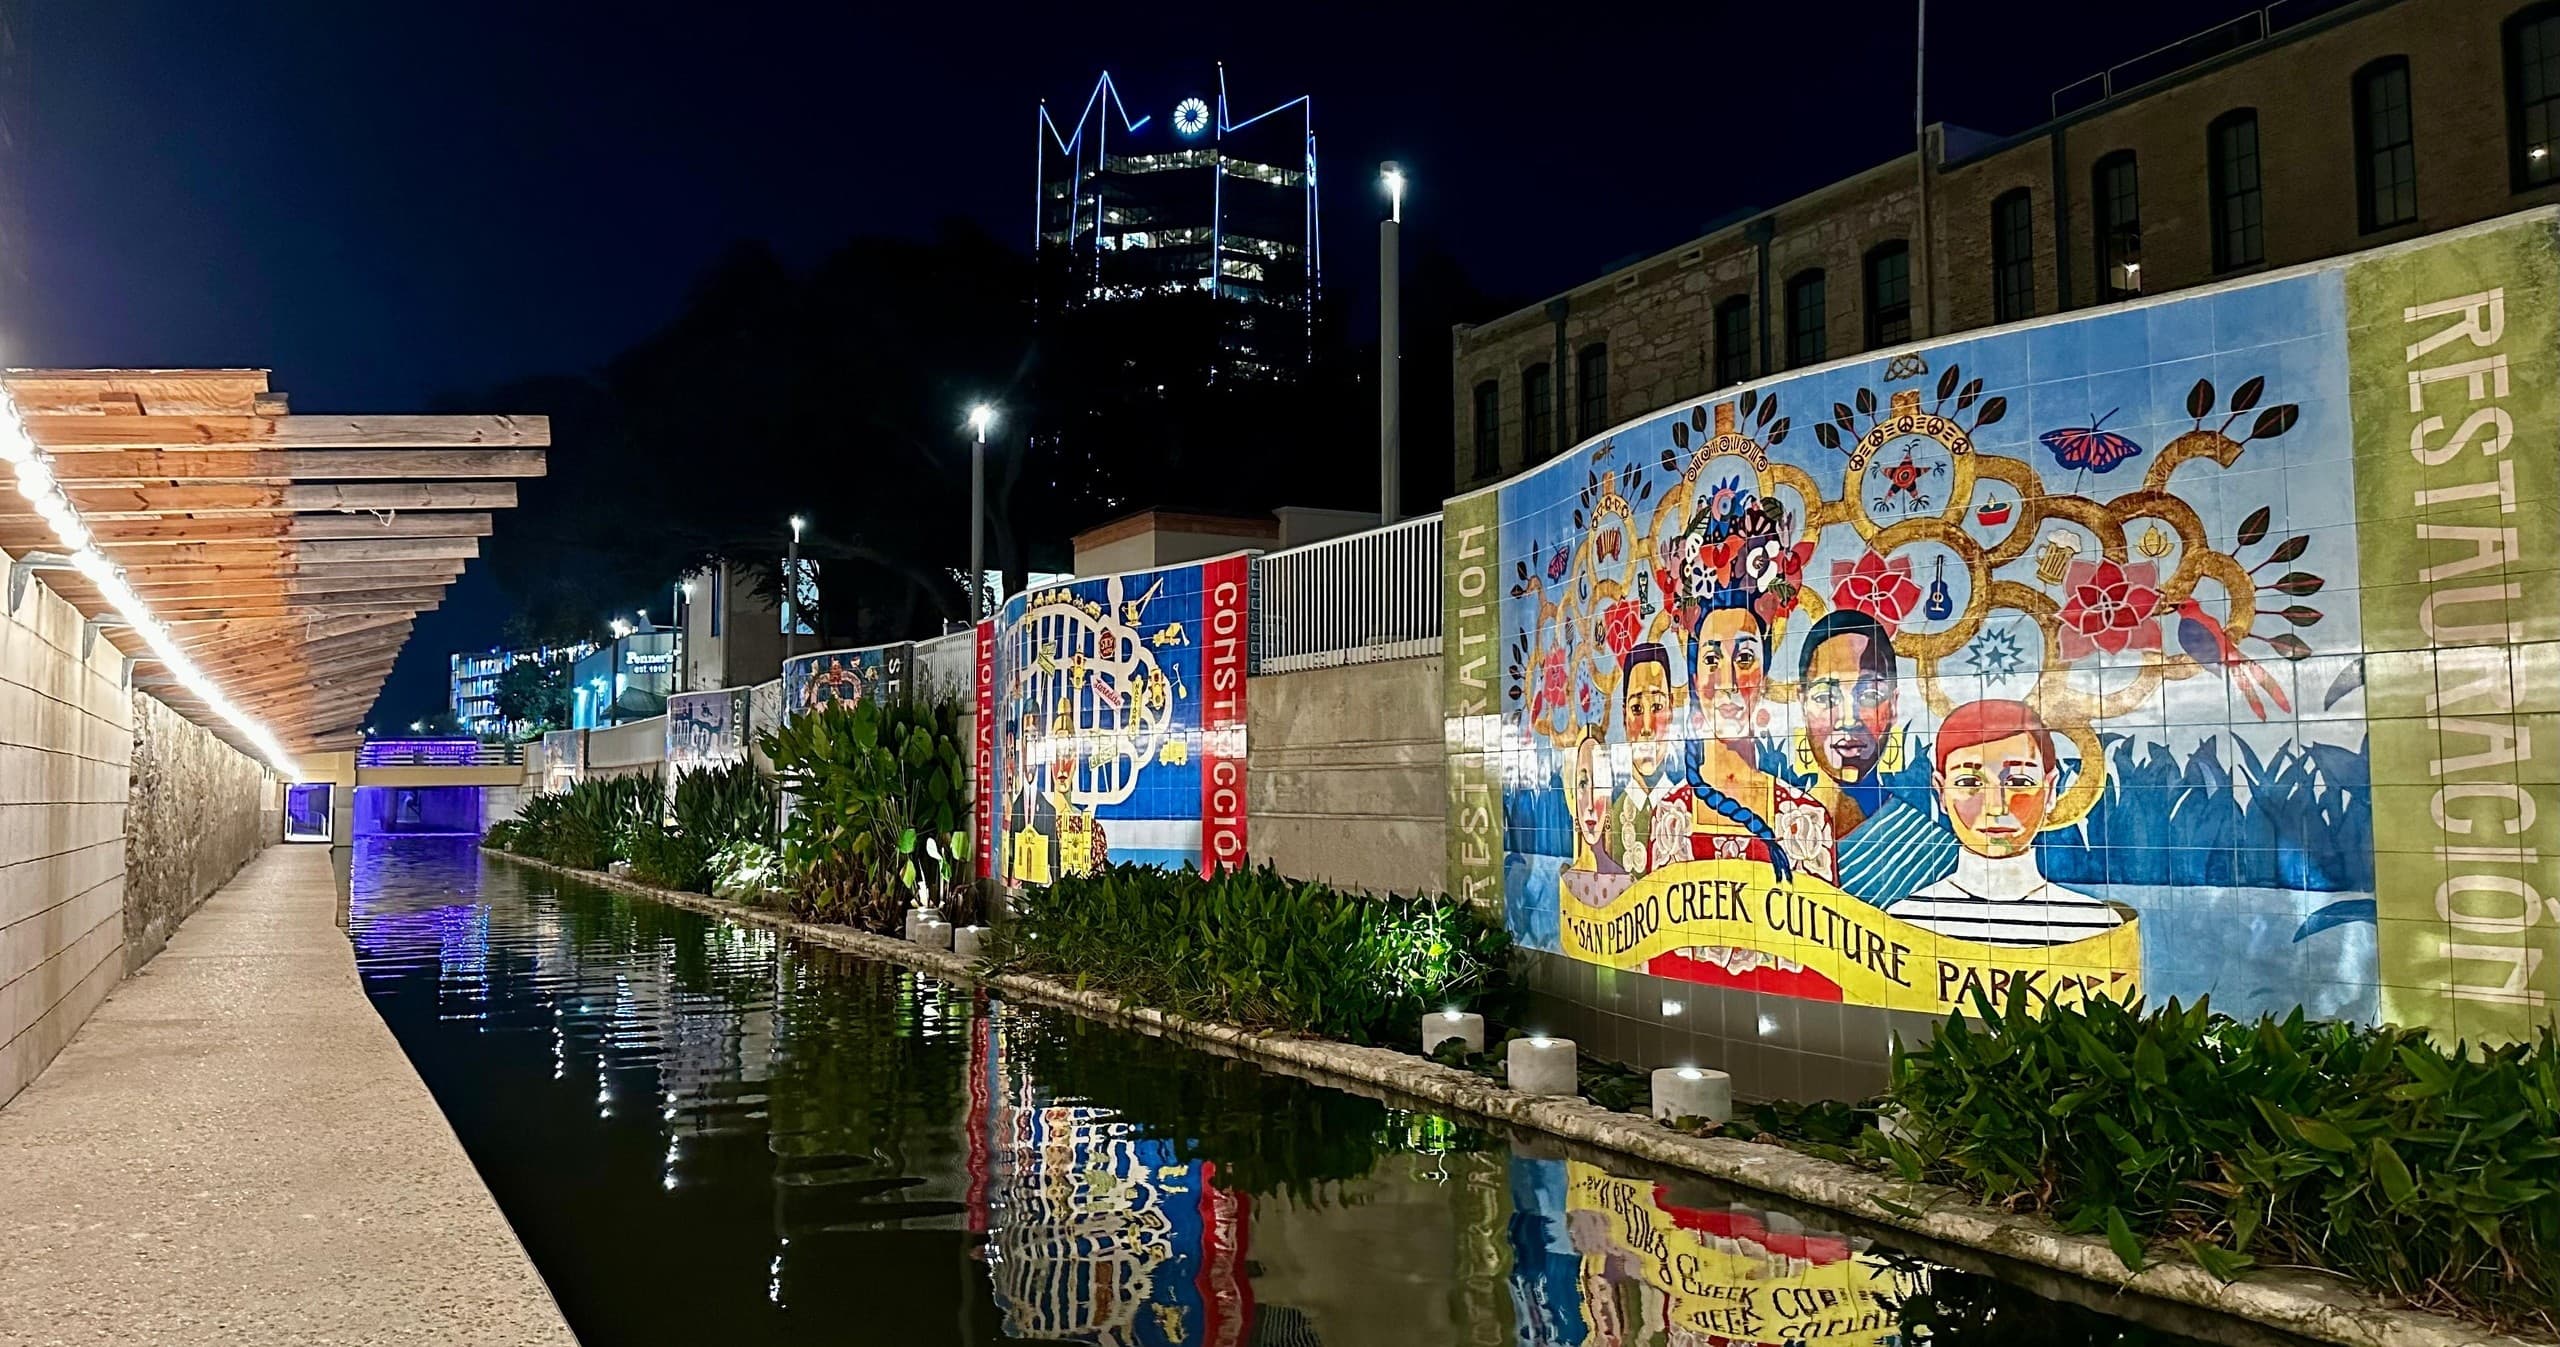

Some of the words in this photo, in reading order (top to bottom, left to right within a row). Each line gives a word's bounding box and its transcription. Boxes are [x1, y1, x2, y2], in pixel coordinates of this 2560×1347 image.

[888, 658, 900, 708] SE
[980, 639, 992, 859] INUNDATION
[1213, 581, 1241, 876] CONSTCCIÓ
[2404, 287, 2560, 1006] RESTAURACIÓN
[1578, 919, 1603, 955] SAN
[1608, 895, 1660, 955] PEDRO
[1666, 881, 1753, 924] CREEK
[1765, 887, 1912, 988] CULTURE
[1937, 960, 2048, 1007] PARK
